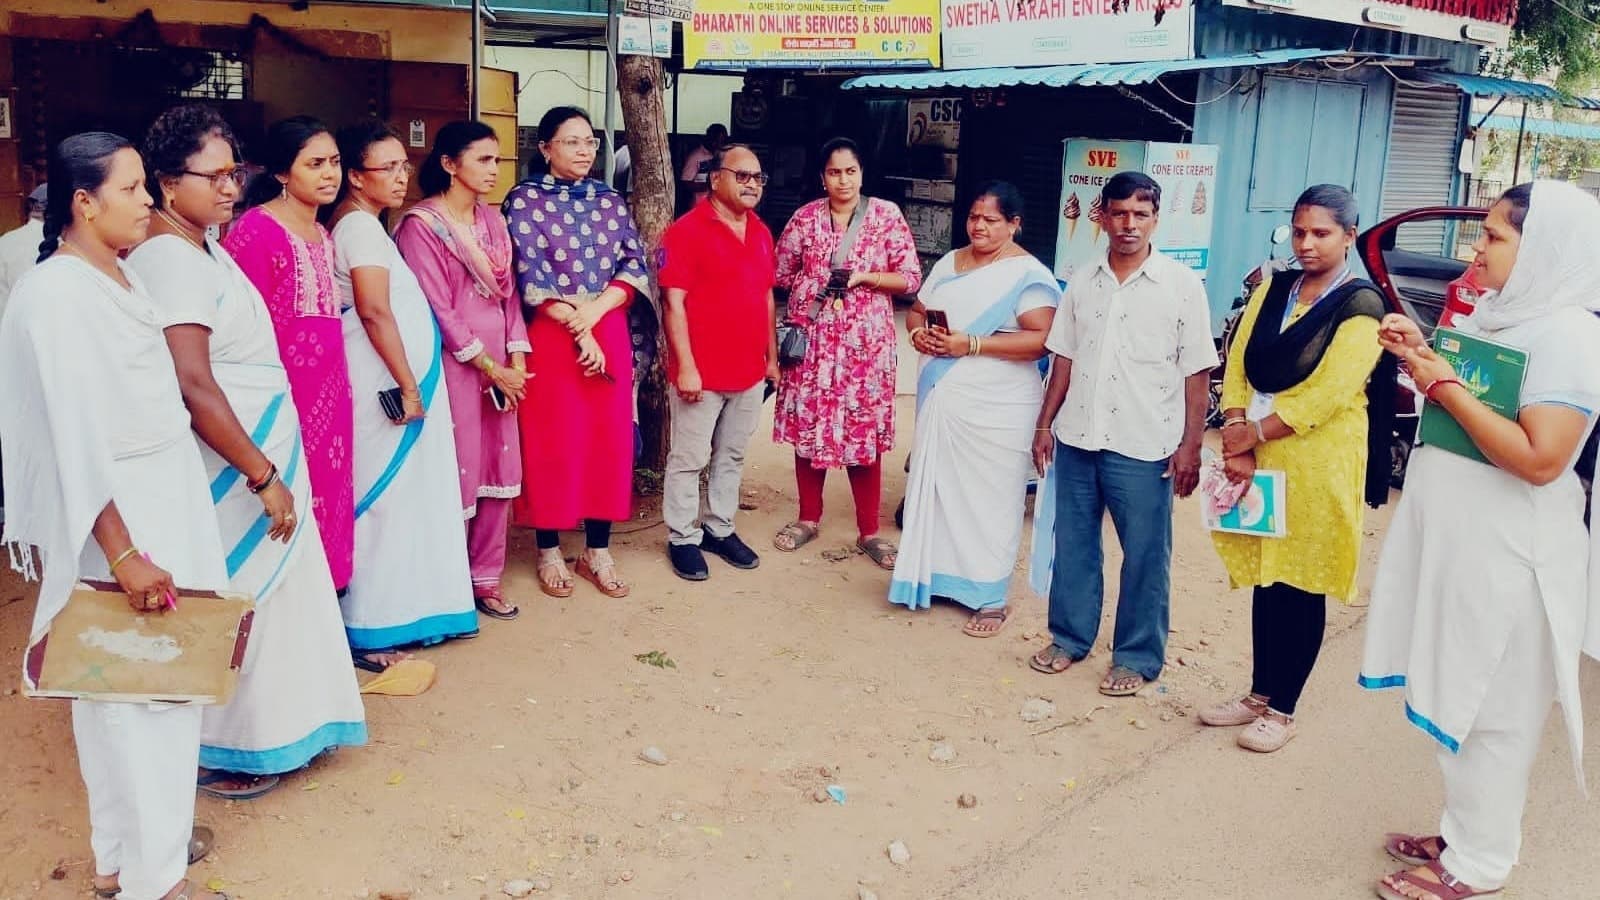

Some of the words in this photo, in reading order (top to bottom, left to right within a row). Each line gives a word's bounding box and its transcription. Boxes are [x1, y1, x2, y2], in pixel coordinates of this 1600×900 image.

[797, 3, 824, 11] ONLINE
[827, 4, 856, 12] SERVICE
[946, 0, 1001, 28] SWETHA
[1005, 0, 1067, 22] VARAHI
[693, 13, 755, 33] BHARATHI
[759, 14, 802, 33] ONLINE
[805, 15, 859, 33] SERVICES
[862, 16, 870, 33] &
[873, 16, 933, 33] SOLUTIONS
[931, 100, 961, 122] CSC
[1088, 151, 1117, 167] SVE
[1152, 164, 1171, 175] CONE
[1173, 165, 1184, 175] ICE
[1186, 165, 1213, 176] CREAMS
[1069, 175, 1089, 185] CONE
[1091, 176, 1103, 186] ICE
